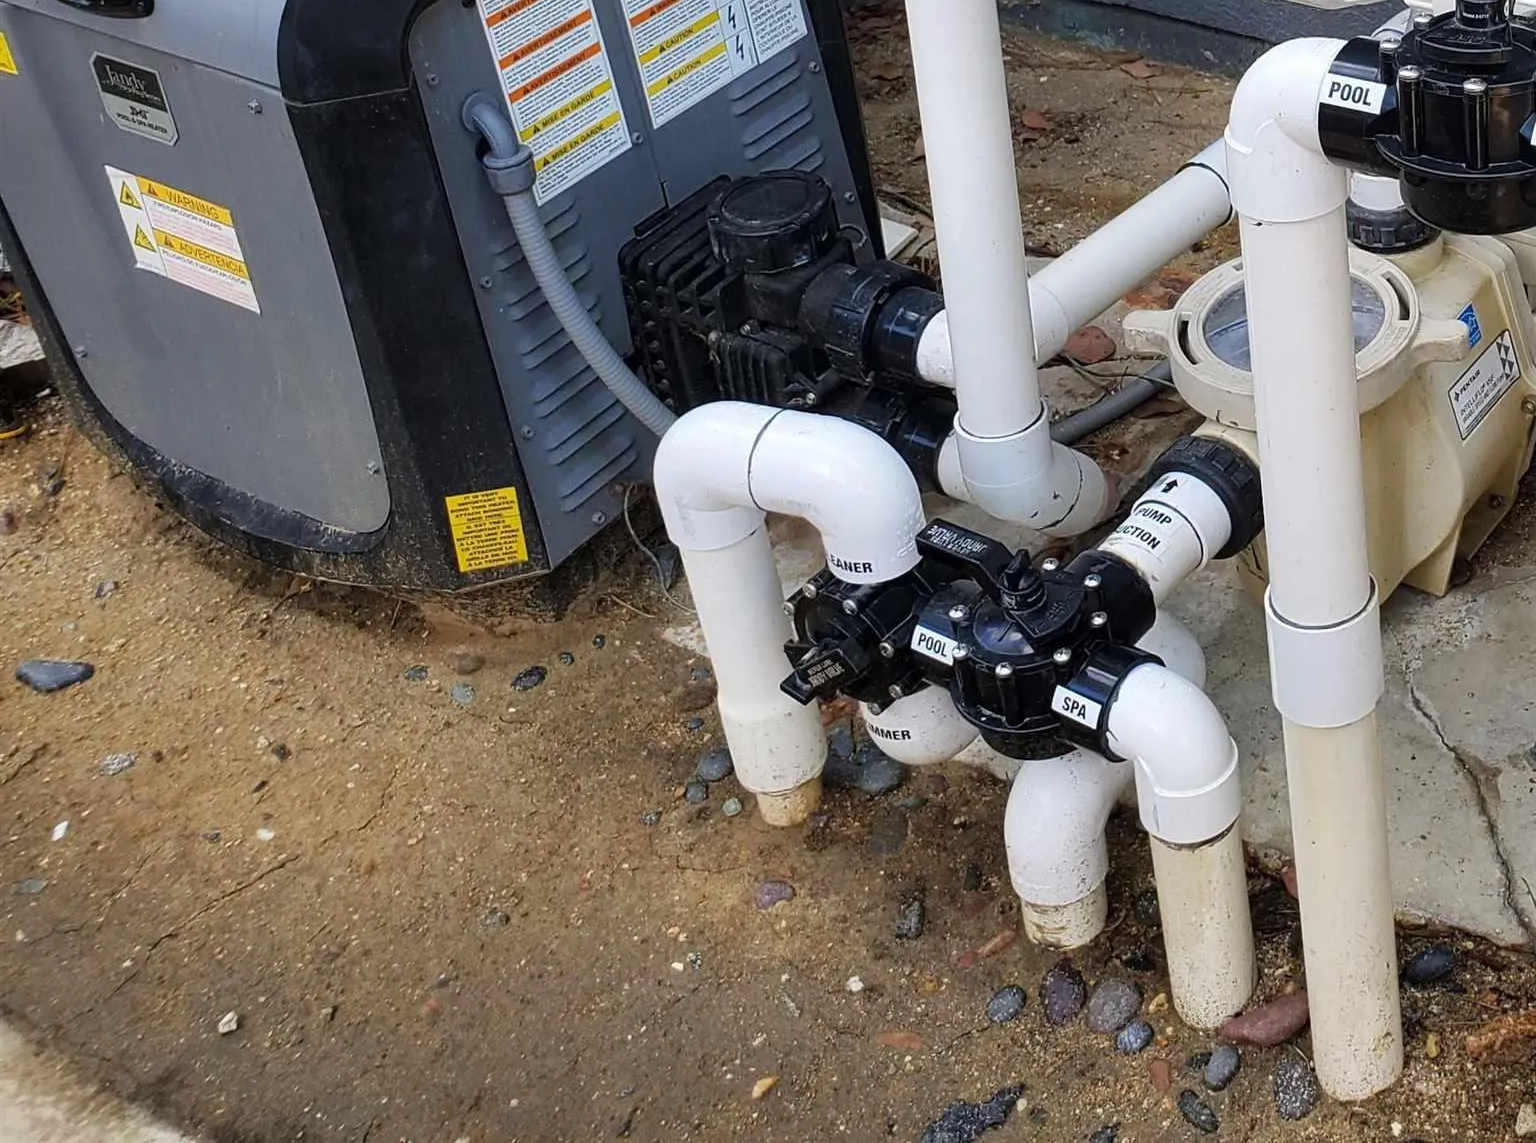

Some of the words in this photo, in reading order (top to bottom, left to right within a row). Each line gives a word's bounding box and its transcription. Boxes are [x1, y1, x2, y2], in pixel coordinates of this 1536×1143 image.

[664, 26, 693, 49] CAUTION
[105, 64, 145, 94] Jandy
[672, 58, 701, 81] CAUTION
[1328, 81, 1372, 107] POOL
[541, 112, 558, 128] MISE
[561, 106, 569, 116] EN
[571, 91, 595, 110] GARDE
[551, 144, 568, 160] MISE
[570, 138, 578, 148] EN
[580, 123, 604, 143] GARDE
[166, 189, 219, 219] WARNING
[180, 241, 246, 276] ADVERTENCIA
[1459, 368, 1480, 394] PENTAIR
[1135, 507, 1172, 524] PUMP
[1115, 525, 1161, 550] UCTION
[917, 632, 949, 658] POOL
[1061, 696, 1087, 720] SPA
